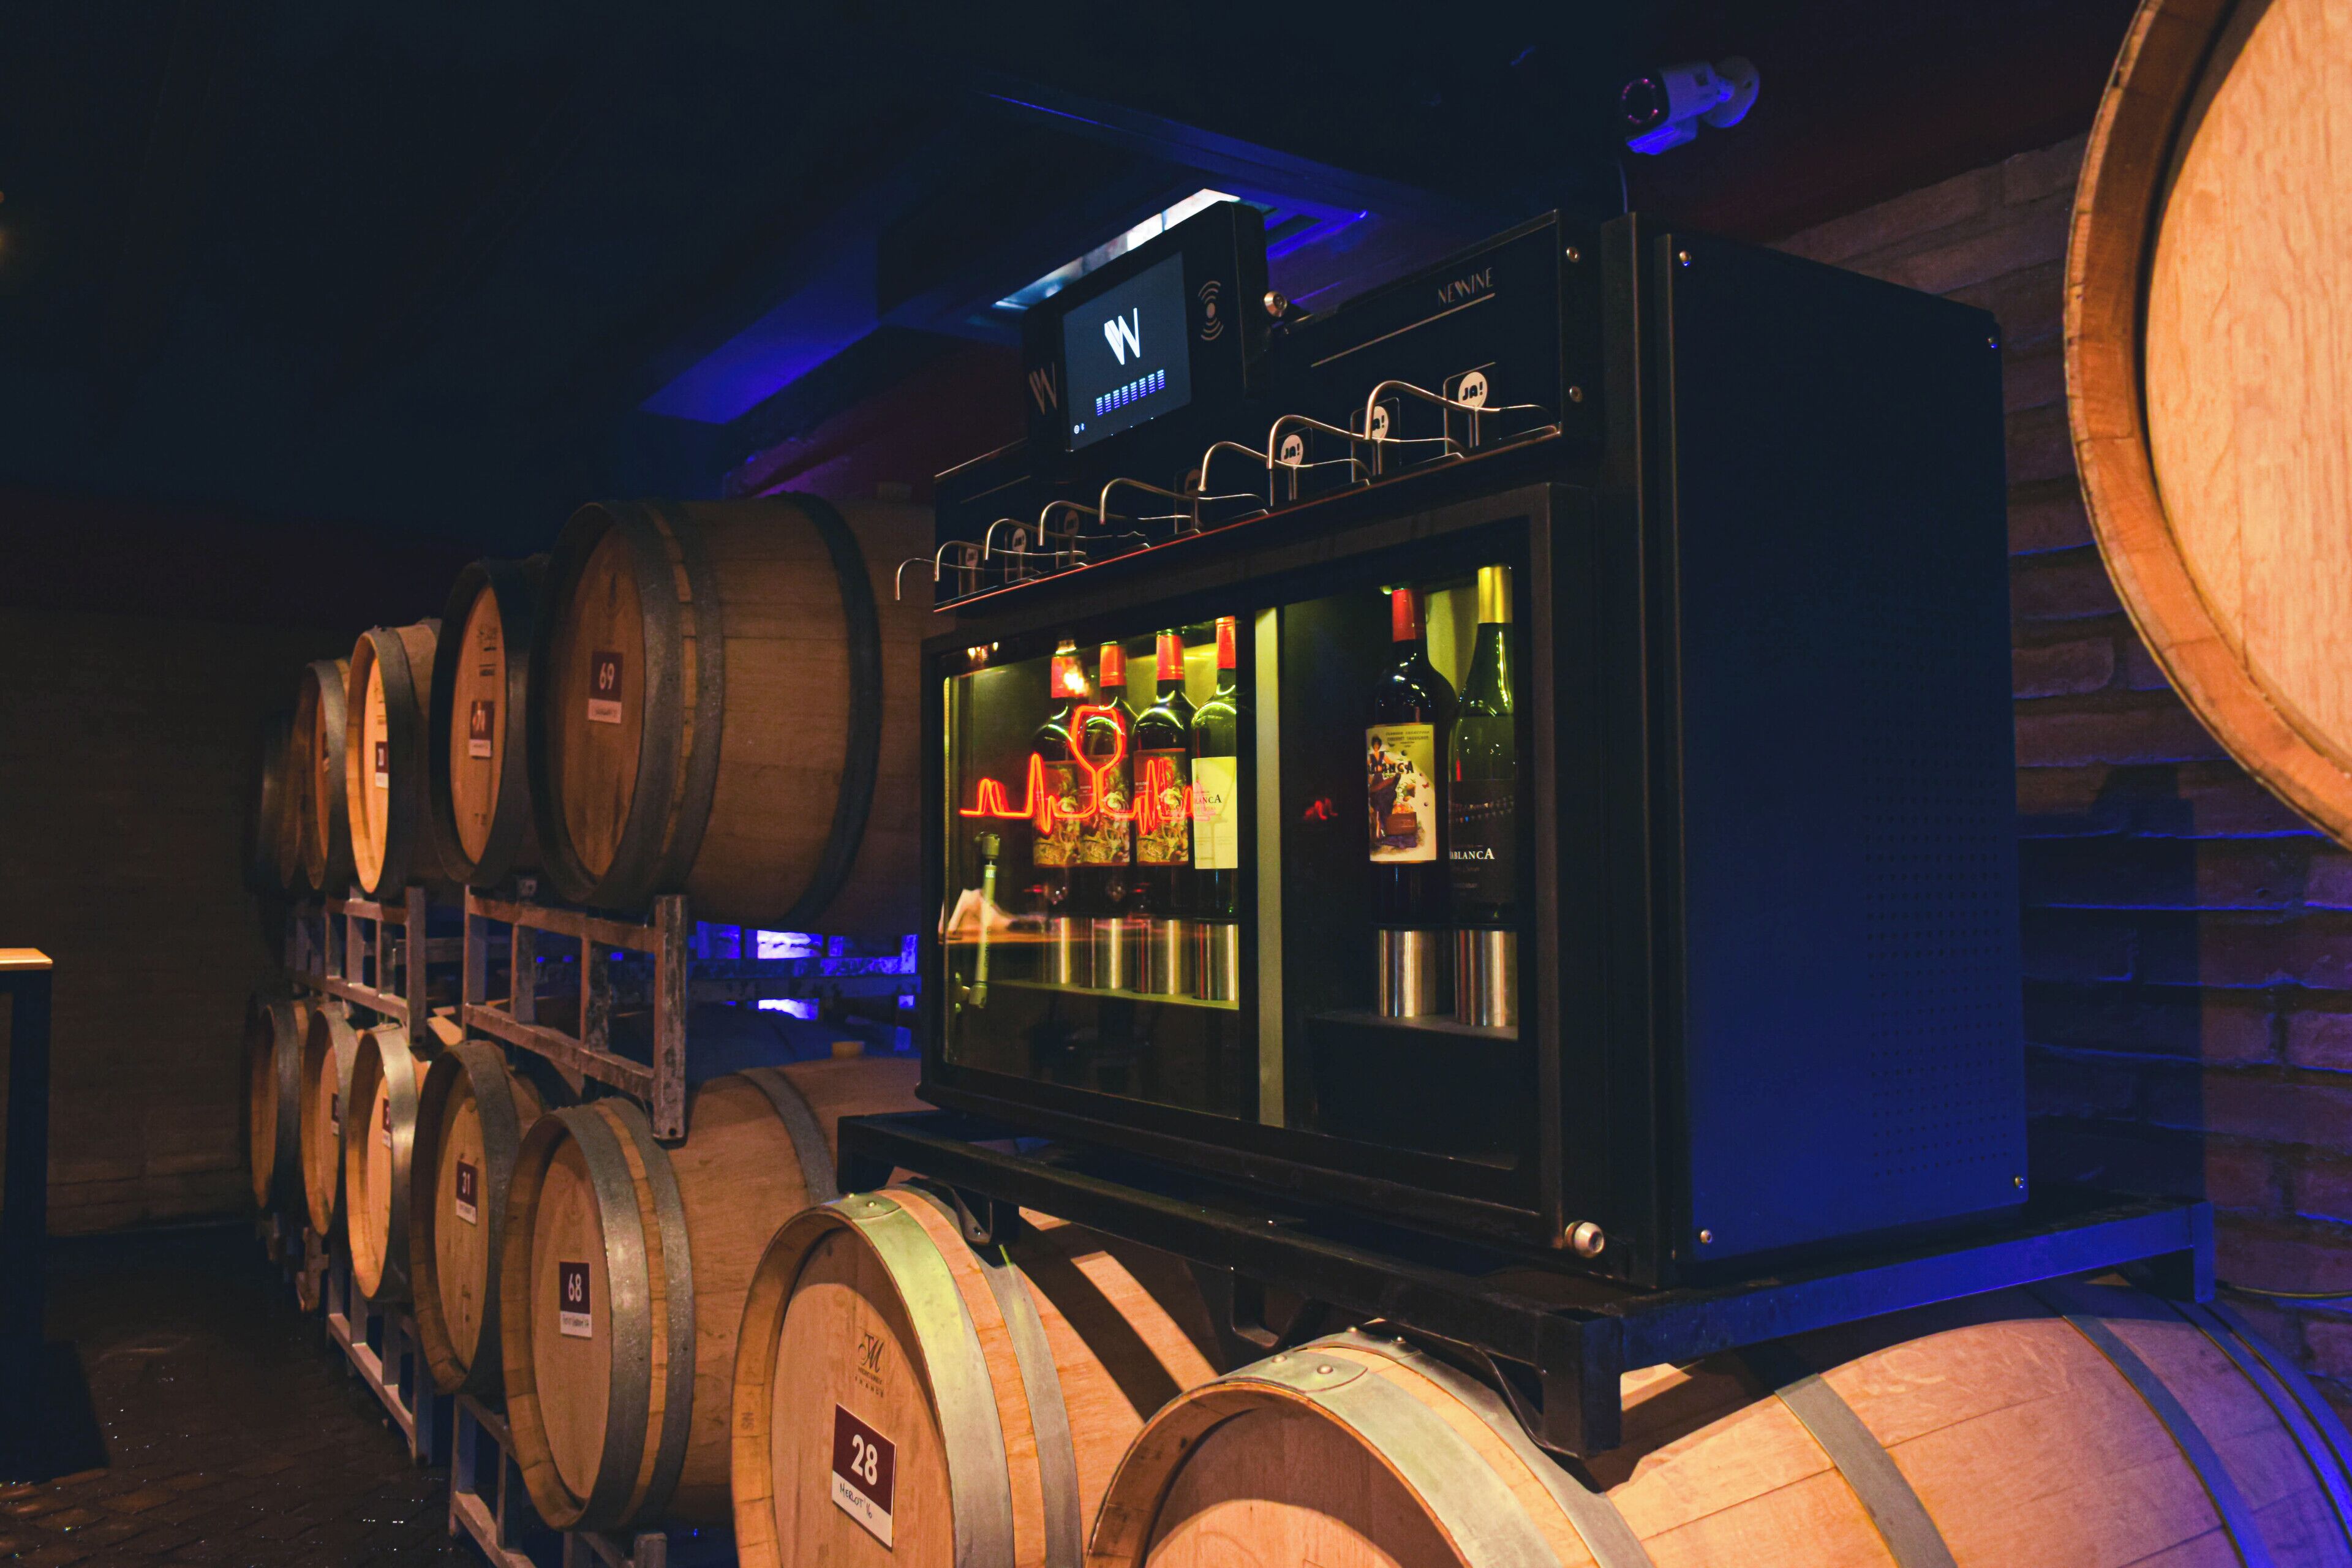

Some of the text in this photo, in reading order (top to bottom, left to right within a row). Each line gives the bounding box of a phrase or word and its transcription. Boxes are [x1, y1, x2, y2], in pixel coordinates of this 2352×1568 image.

[1462, 381, 1483, 401] JA!
[1371, 415, 1385, 431] A!
[1283, 443, 1300, 460] JA!
[599, 662, 615, 690] 69
[568, 1273, 582, 1302] 68
[851, 1434, 878, 1486] 28
[840, 1482, 864, 1508] MERLOT
